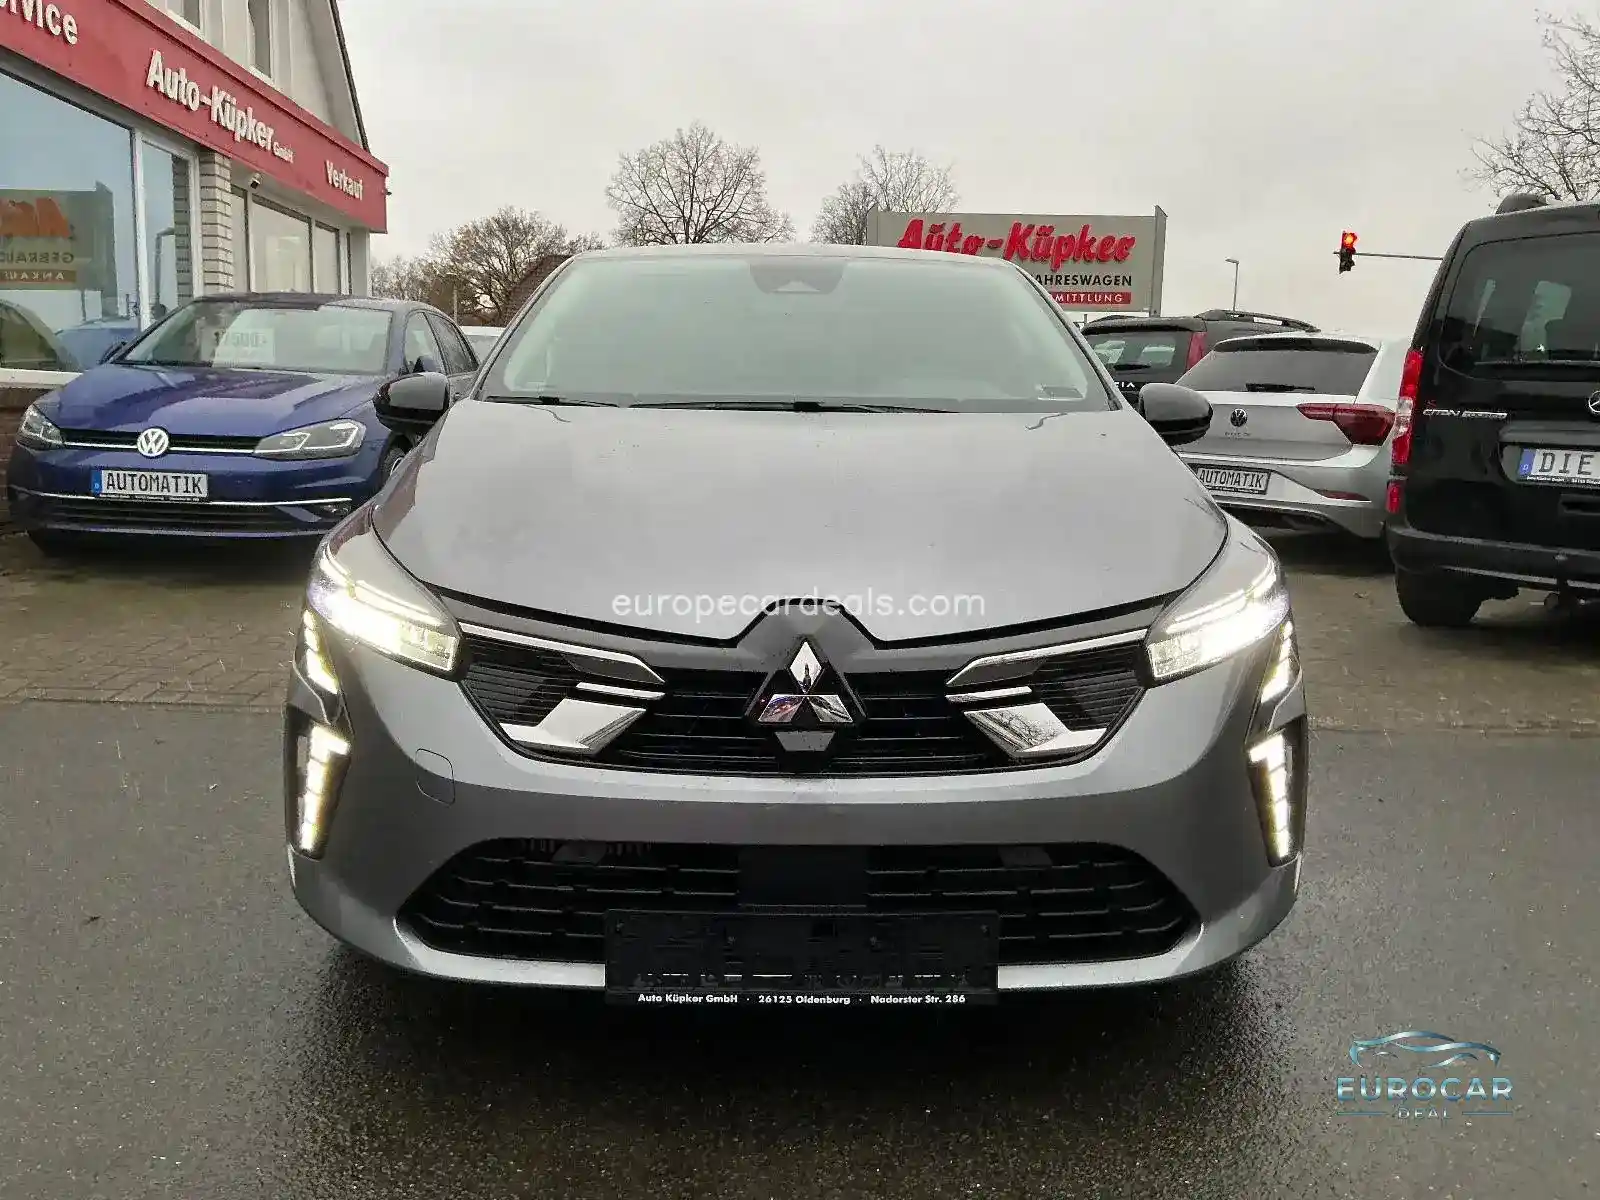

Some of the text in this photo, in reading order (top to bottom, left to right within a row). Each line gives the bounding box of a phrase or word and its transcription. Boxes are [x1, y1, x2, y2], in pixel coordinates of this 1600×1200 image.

[0, 0, 78, 45] vice
[146, 47, 275, 151] Auto-Küpker
[324, 159, 364, 200] Verkauf
[1031, 273, 1133, 288] AHRESWAGEN
[1051, 293, 1123, 303] MITTLUNG
[106, 472, 203, 494] AUTOMATIK
[1199, 469, 1264, 489] AUTOMATIK
[637, 993, 663, 1002] Auto
[705, 994, 738, 1003] GmbH
[758, 994, 792, 1004] 26125
[795, 995, 851, 1005] Oldenburg
[924, 994, 943, 1004] Str.
[945, 994, 966, 1004] 286
